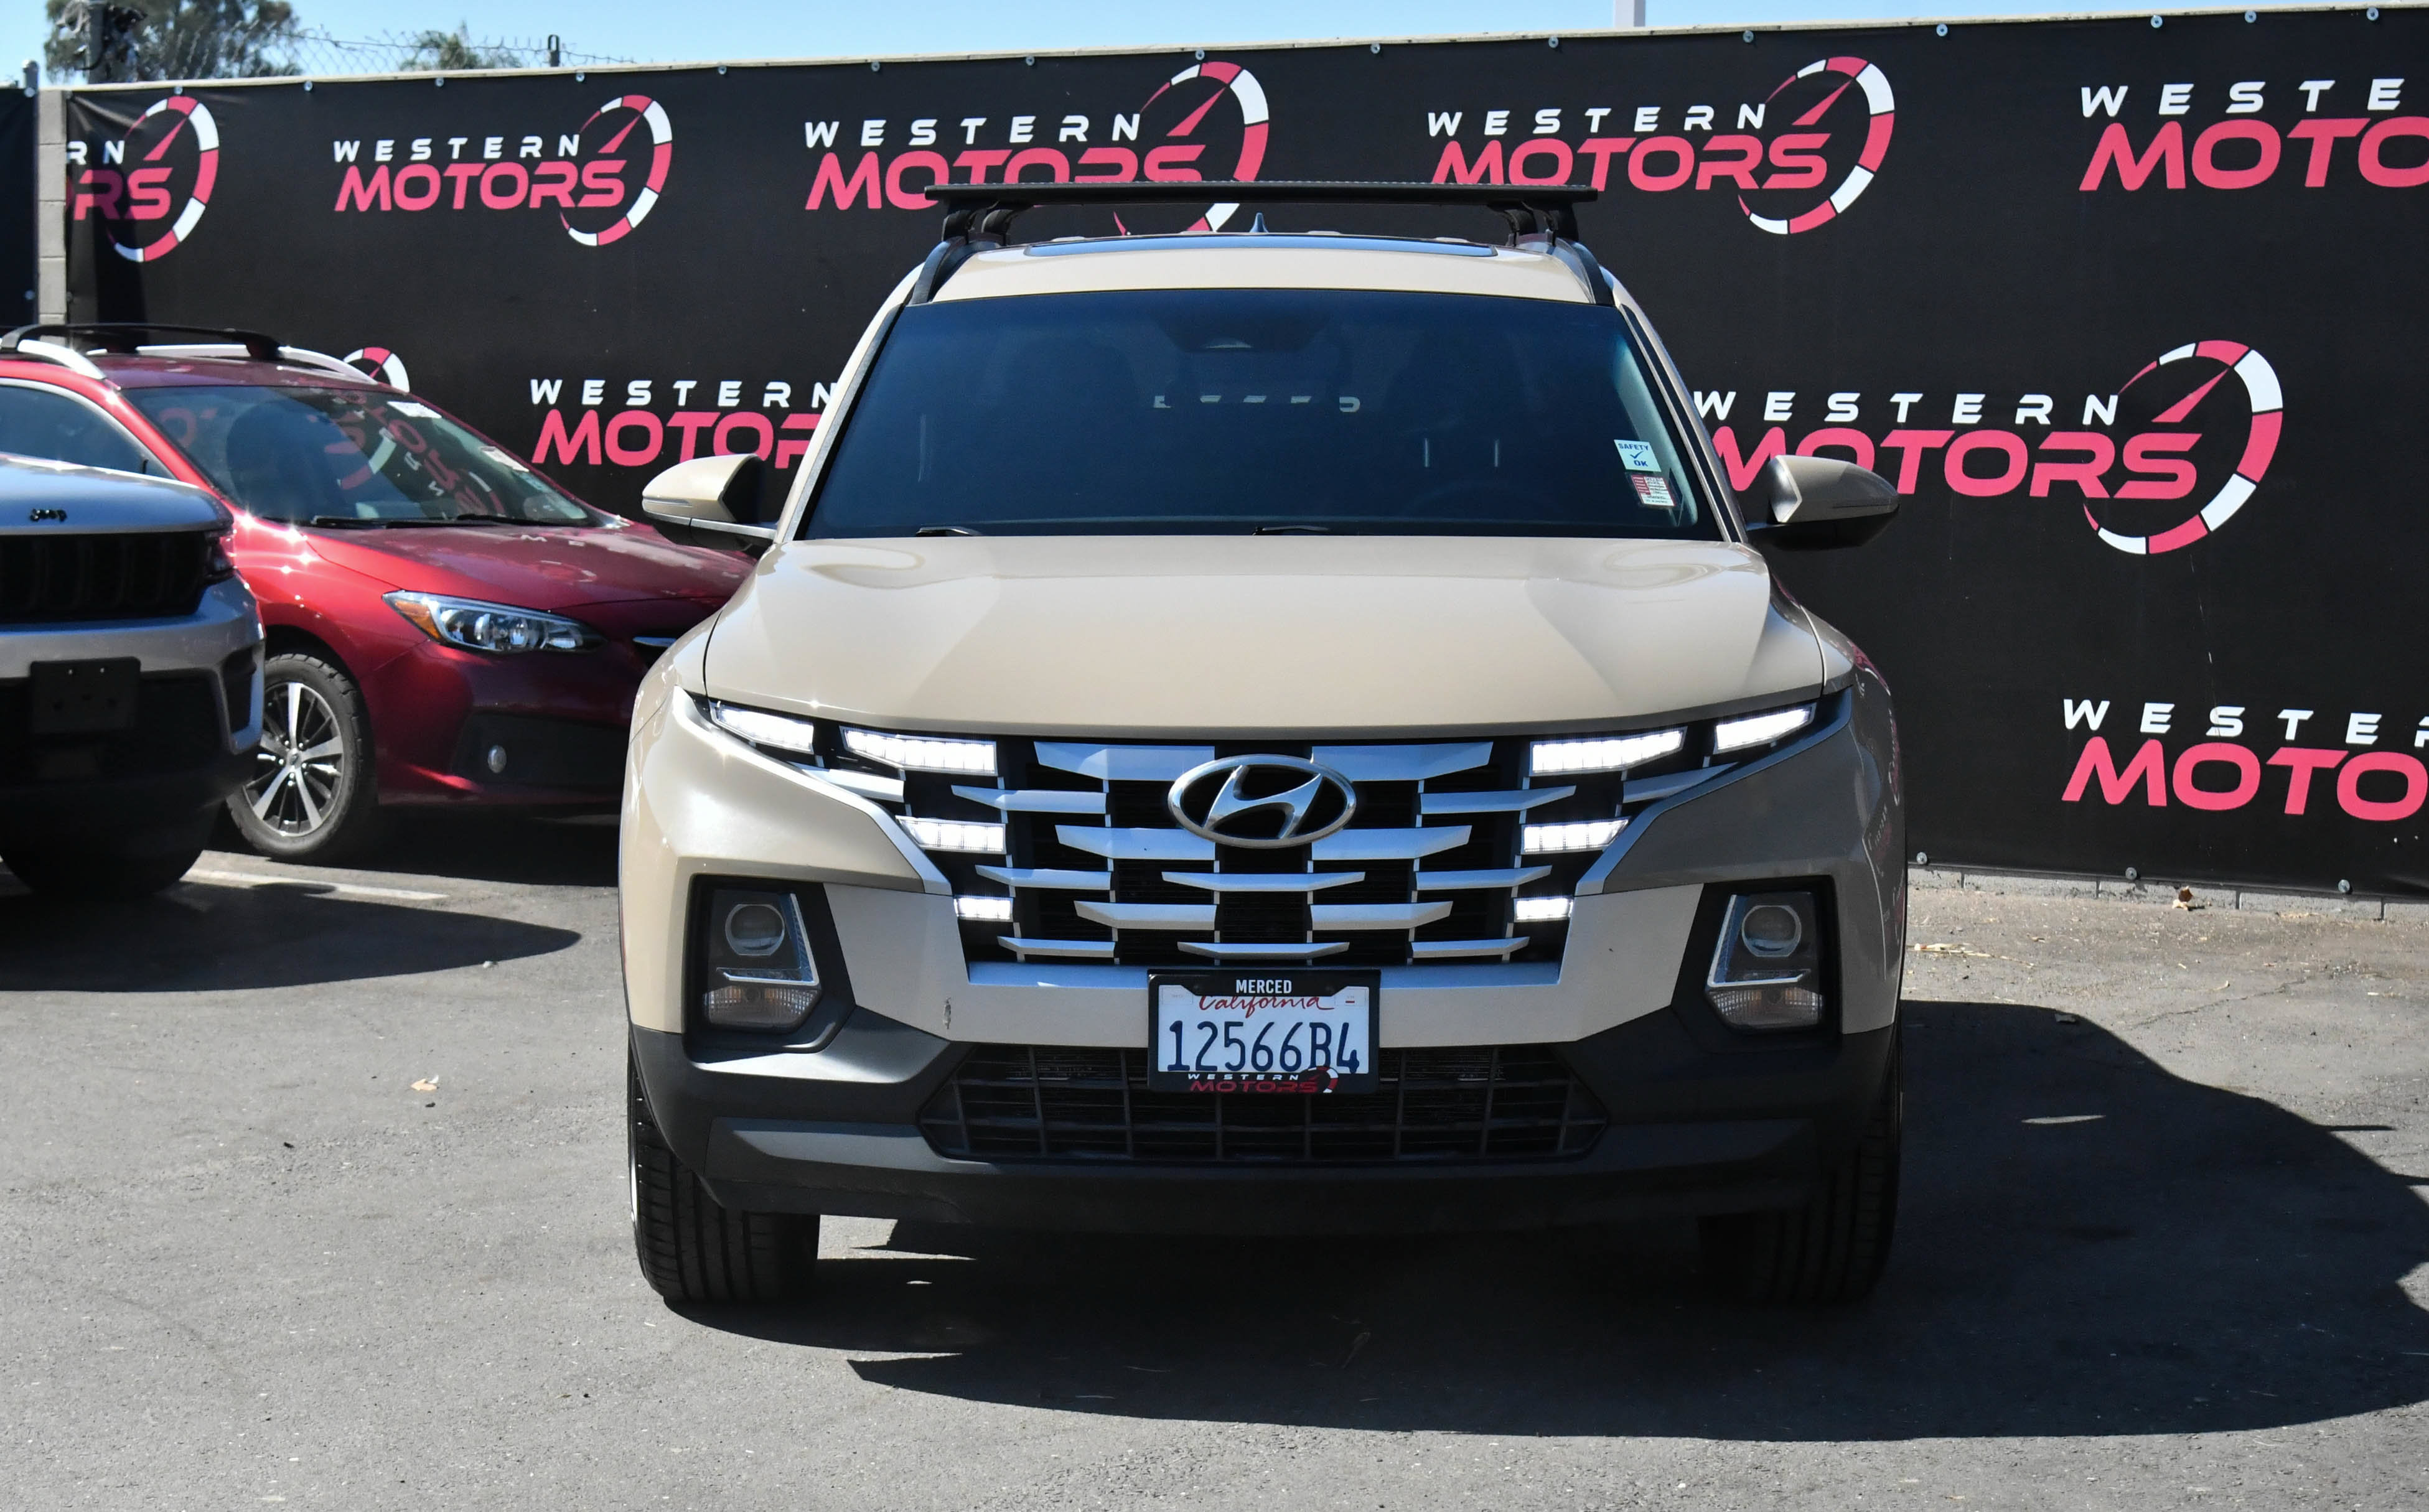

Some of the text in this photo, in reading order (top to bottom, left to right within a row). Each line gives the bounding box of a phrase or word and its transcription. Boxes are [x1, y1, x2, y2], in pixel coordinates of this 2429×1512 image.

[805, 114, 1140, 148] WESTERN
[1428, 104, 1766, 136] WESTERN
[334, 134, 580, 162] WESTERN
[1432, 134, 1831, 192] MOTORS
[335, 159, 627, 212] MOTORS
[531, 380, 837, 409] WESTERN
[1693, 391, 2118, 426] WESTERN
[1235, 979, 1293, 994] MERCED
[1199, 995, 1335, 1019] California
[1167, 1020, 1360, 1074] 12566B4
[1189, 1080, 1319, 1093] MOTORS
